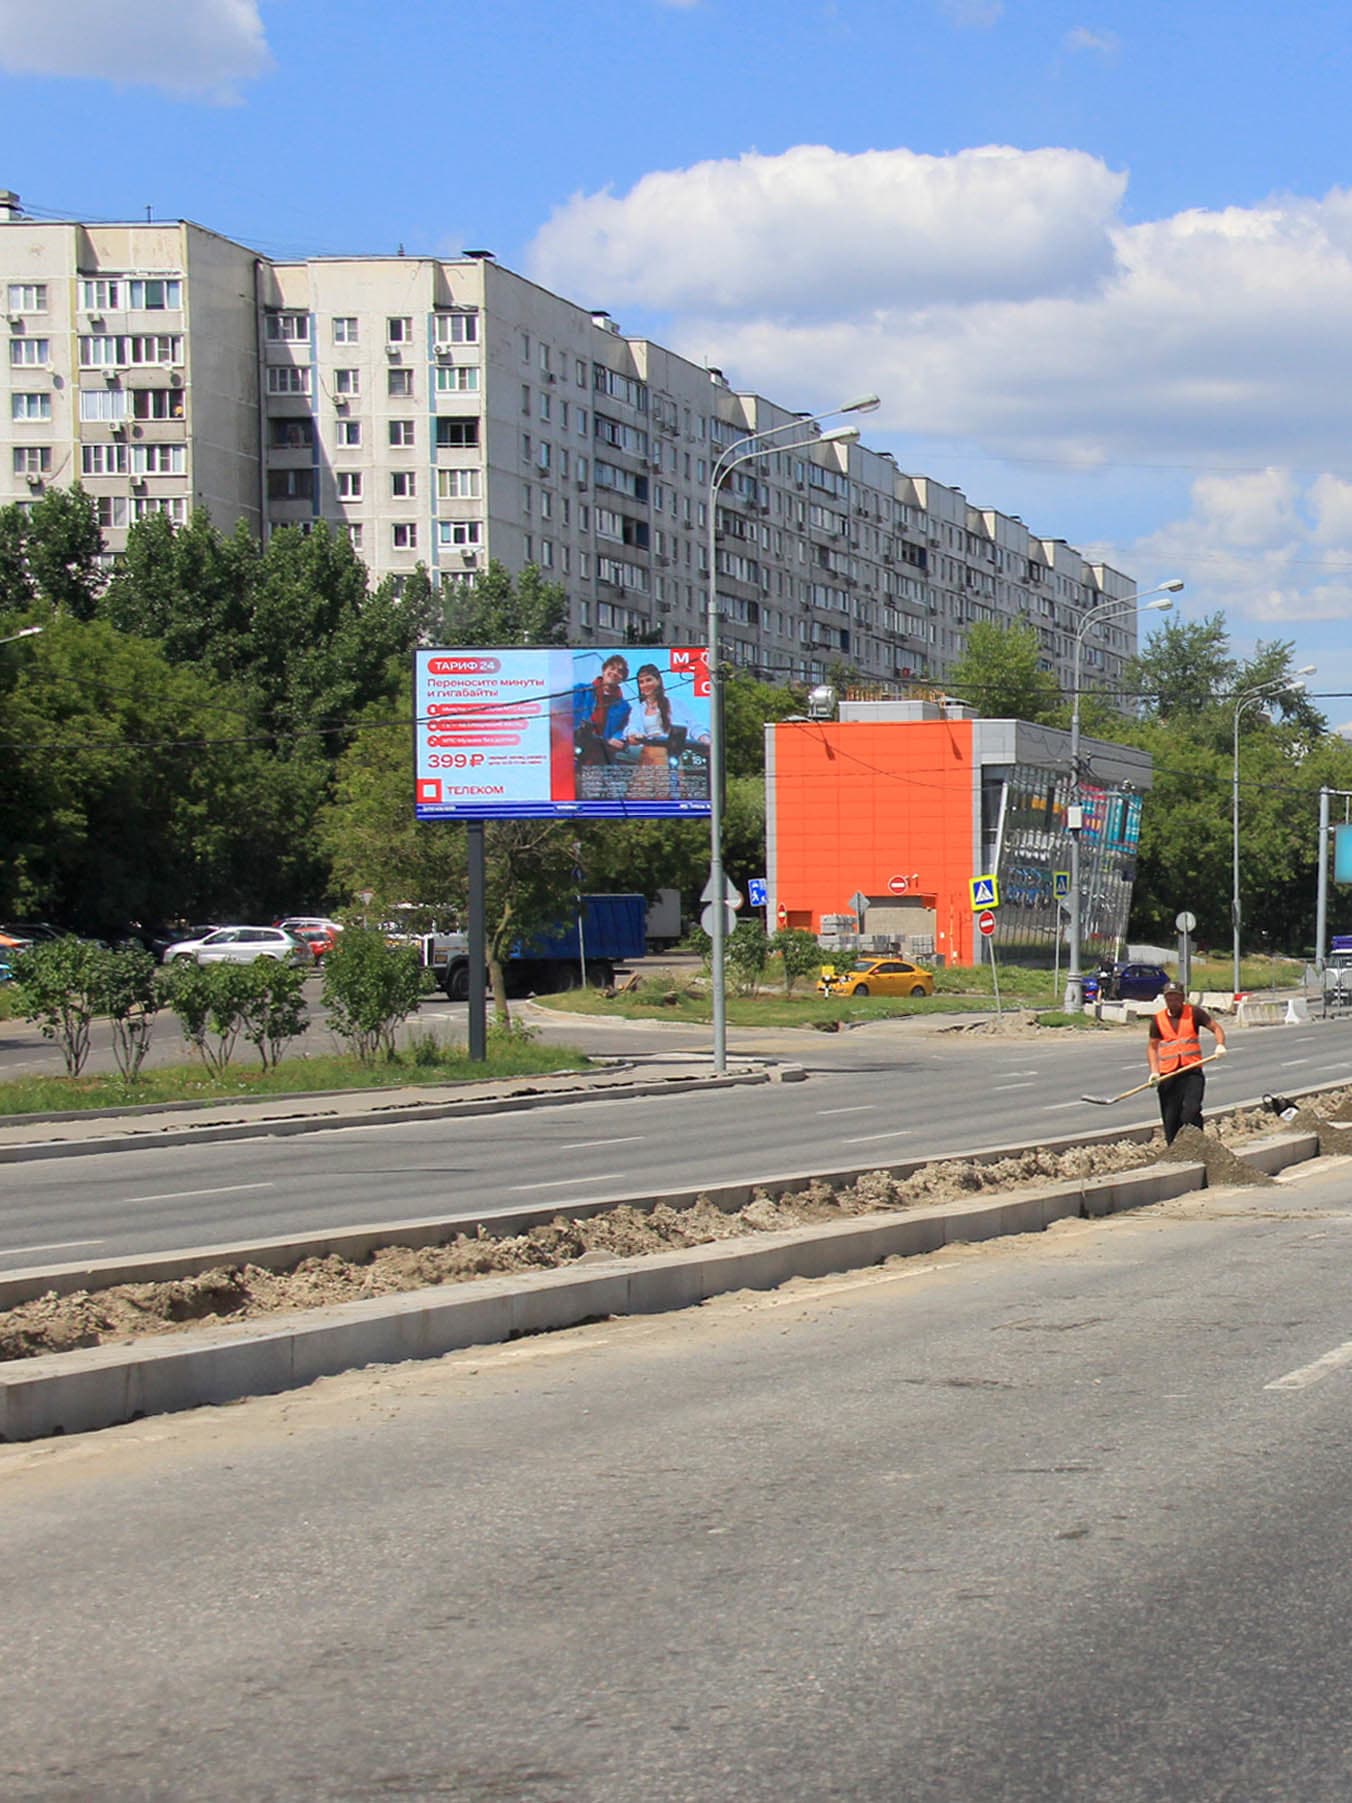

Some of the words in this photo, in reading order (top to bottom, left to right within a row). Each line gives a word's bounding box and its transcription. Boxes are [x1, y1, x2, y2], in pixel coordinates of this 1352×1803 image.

[435, 661, 478, 671] ТАРИФ
[480, 661, 496, 671] 24
[427, 678, 498, 689] Переносите
[500, 678, 545, 688] минуты
[437, 688, 498, 697] гигабайты
[428, 754, 467, 768] 399
[447, 785, 504, 795] ТЕЛЕКОМ
